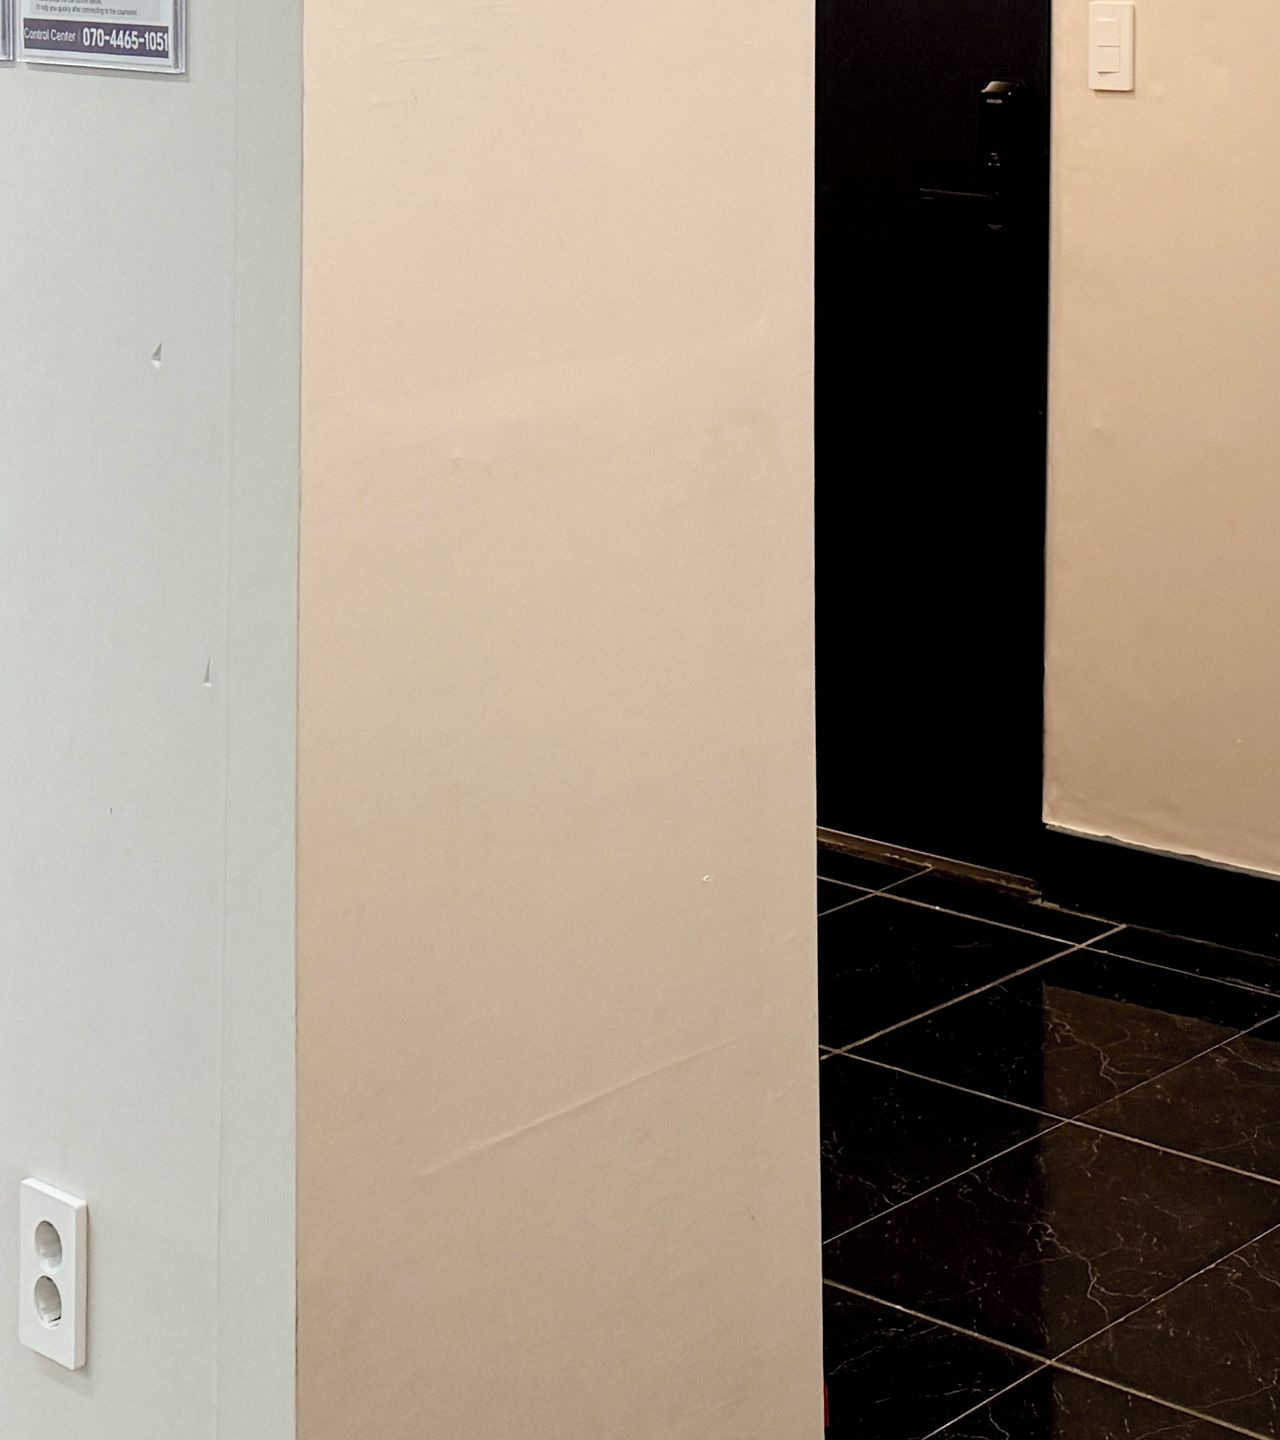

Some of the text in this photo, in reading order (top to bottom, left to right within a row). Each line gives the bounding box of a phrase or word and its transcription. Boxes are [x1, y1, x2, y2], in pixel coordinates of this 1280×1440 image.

[24, 27, 168, 52] Control Center 070-4465-1051
